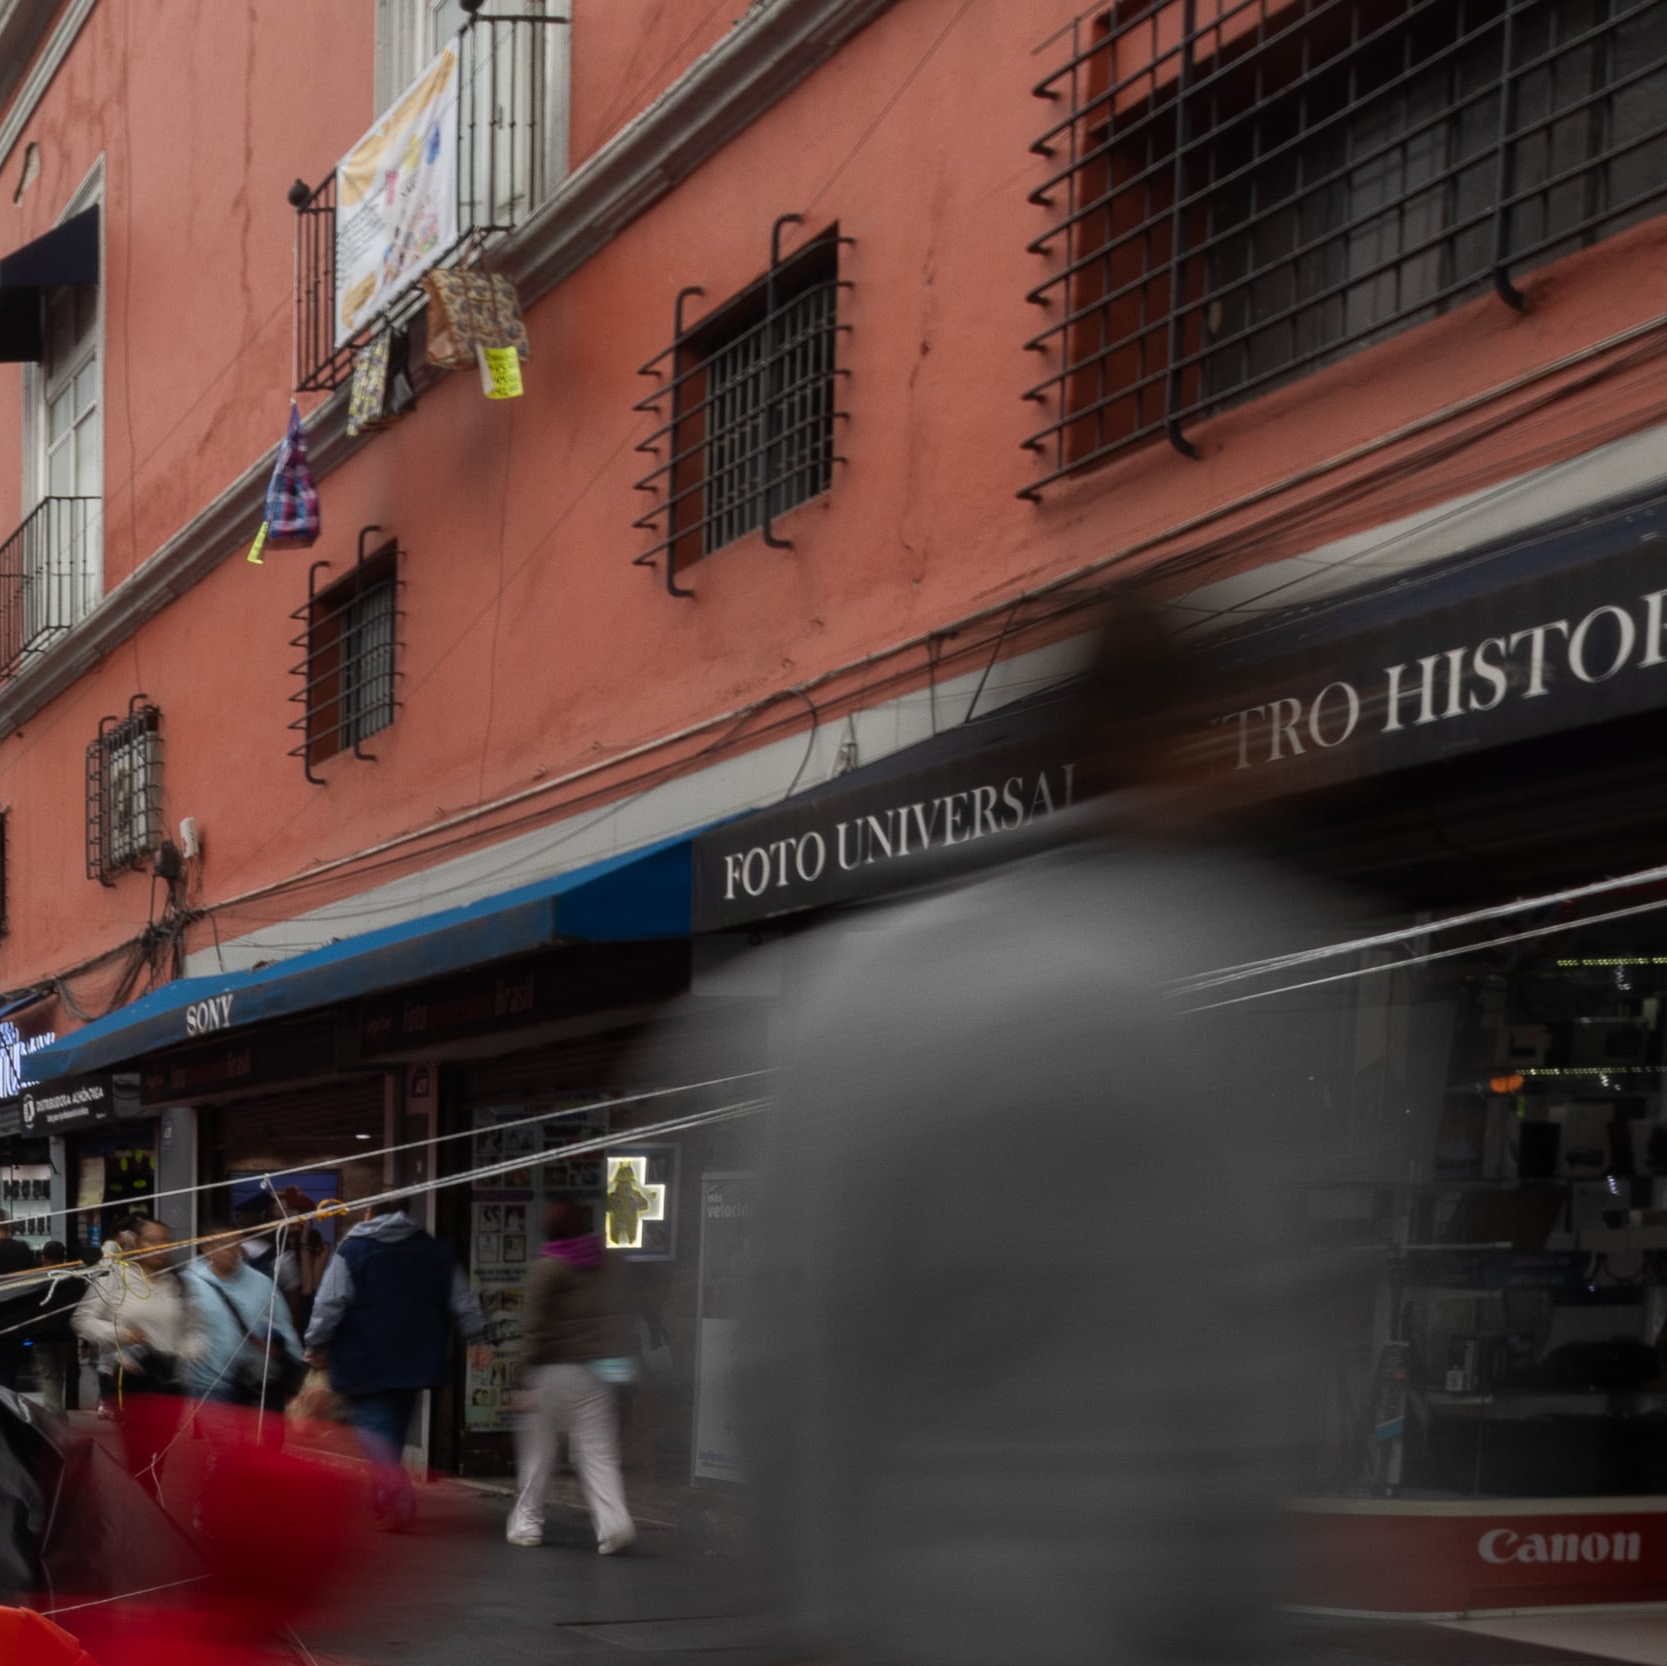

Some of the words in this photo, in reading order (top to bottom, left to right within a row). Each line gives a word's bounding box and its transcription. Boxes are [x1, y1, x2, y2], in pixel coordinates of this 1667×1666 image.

[722, 830, 827, 900] FOTO
[1212, 681, 1360, 770] TRO
[186, 993, 234, 1037] SONY
[1477, 1528, 1642, 1565] Canon
